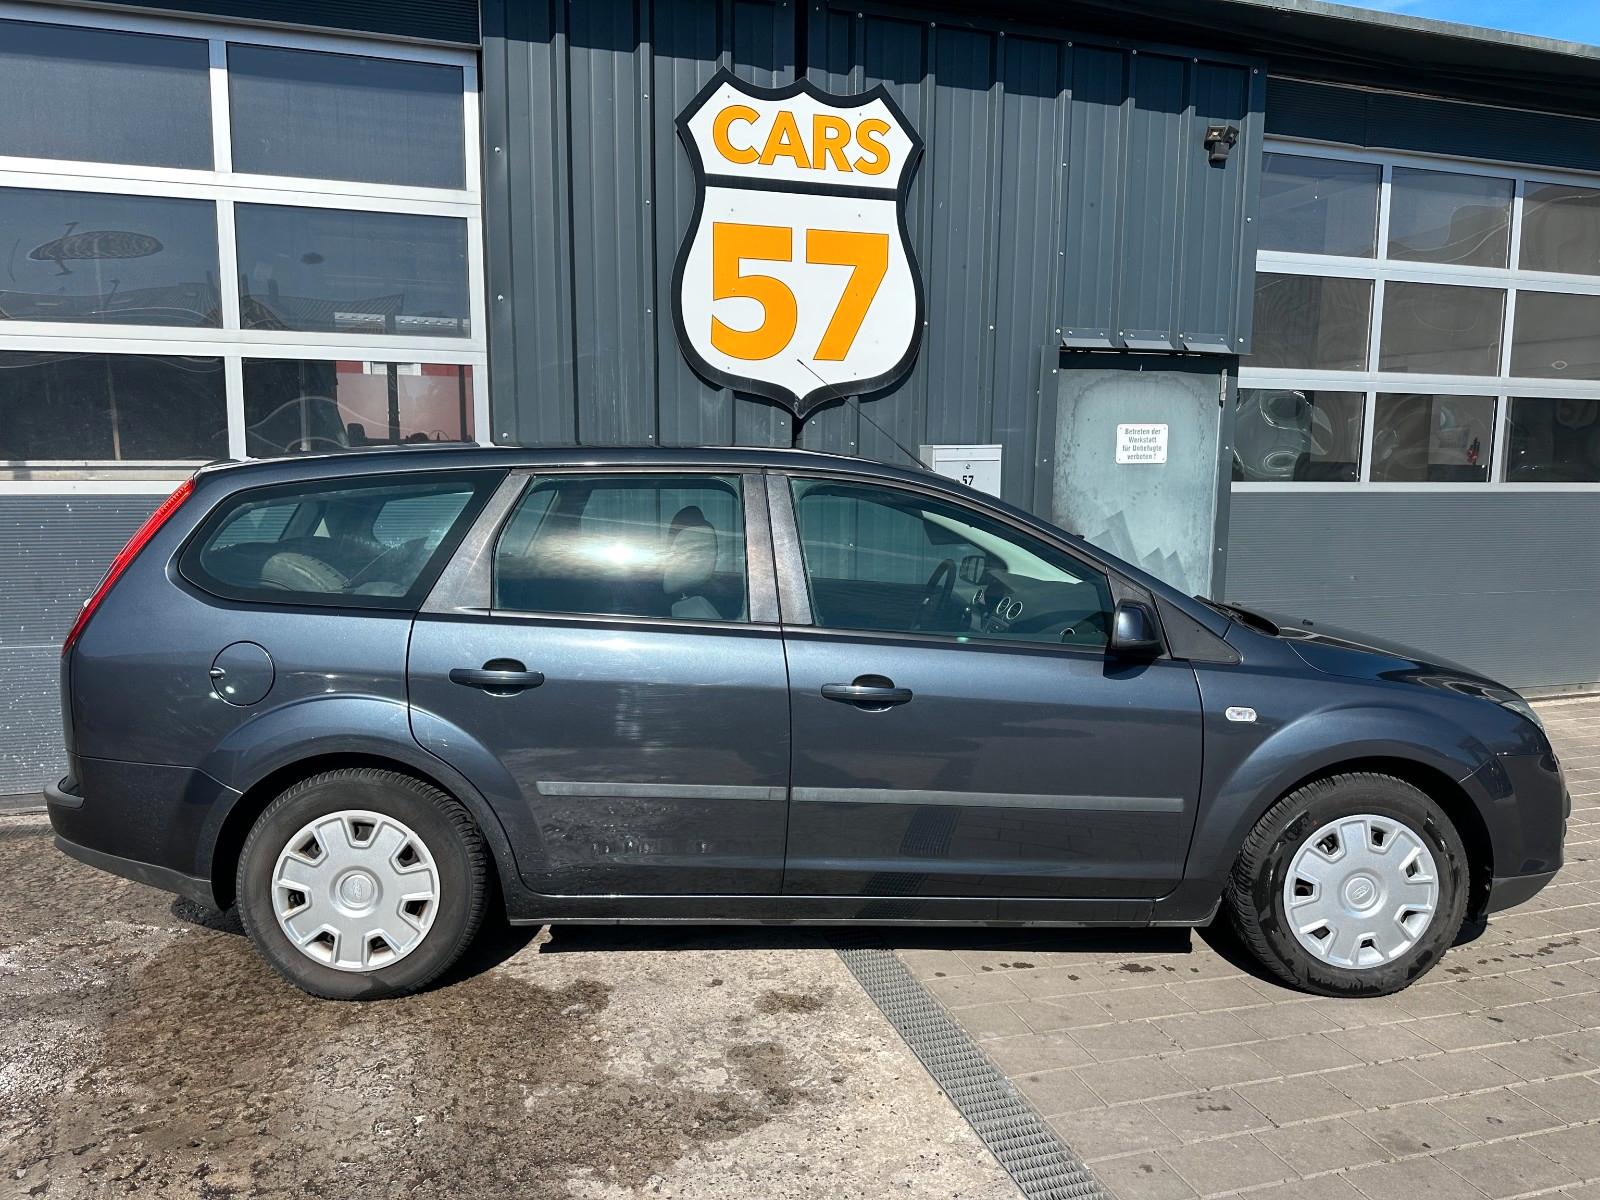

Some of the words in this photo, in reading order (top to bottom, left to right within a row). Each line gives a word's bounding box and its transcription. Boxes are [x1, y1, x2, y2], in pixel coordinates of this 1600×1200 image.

[712, 105, 892, 176] CARS
[710, 221, 890, 362] 57
[1124, 427, 1150, 435] Betreten
[1151, 427, 1161, 435] der
[1128, 436, 1157, 444] Werkstatt
[1122, 444, 1131, 452] für
[1132, 444, 1162, 453] Unbefugte
[962, 474, 974, 486] 57
